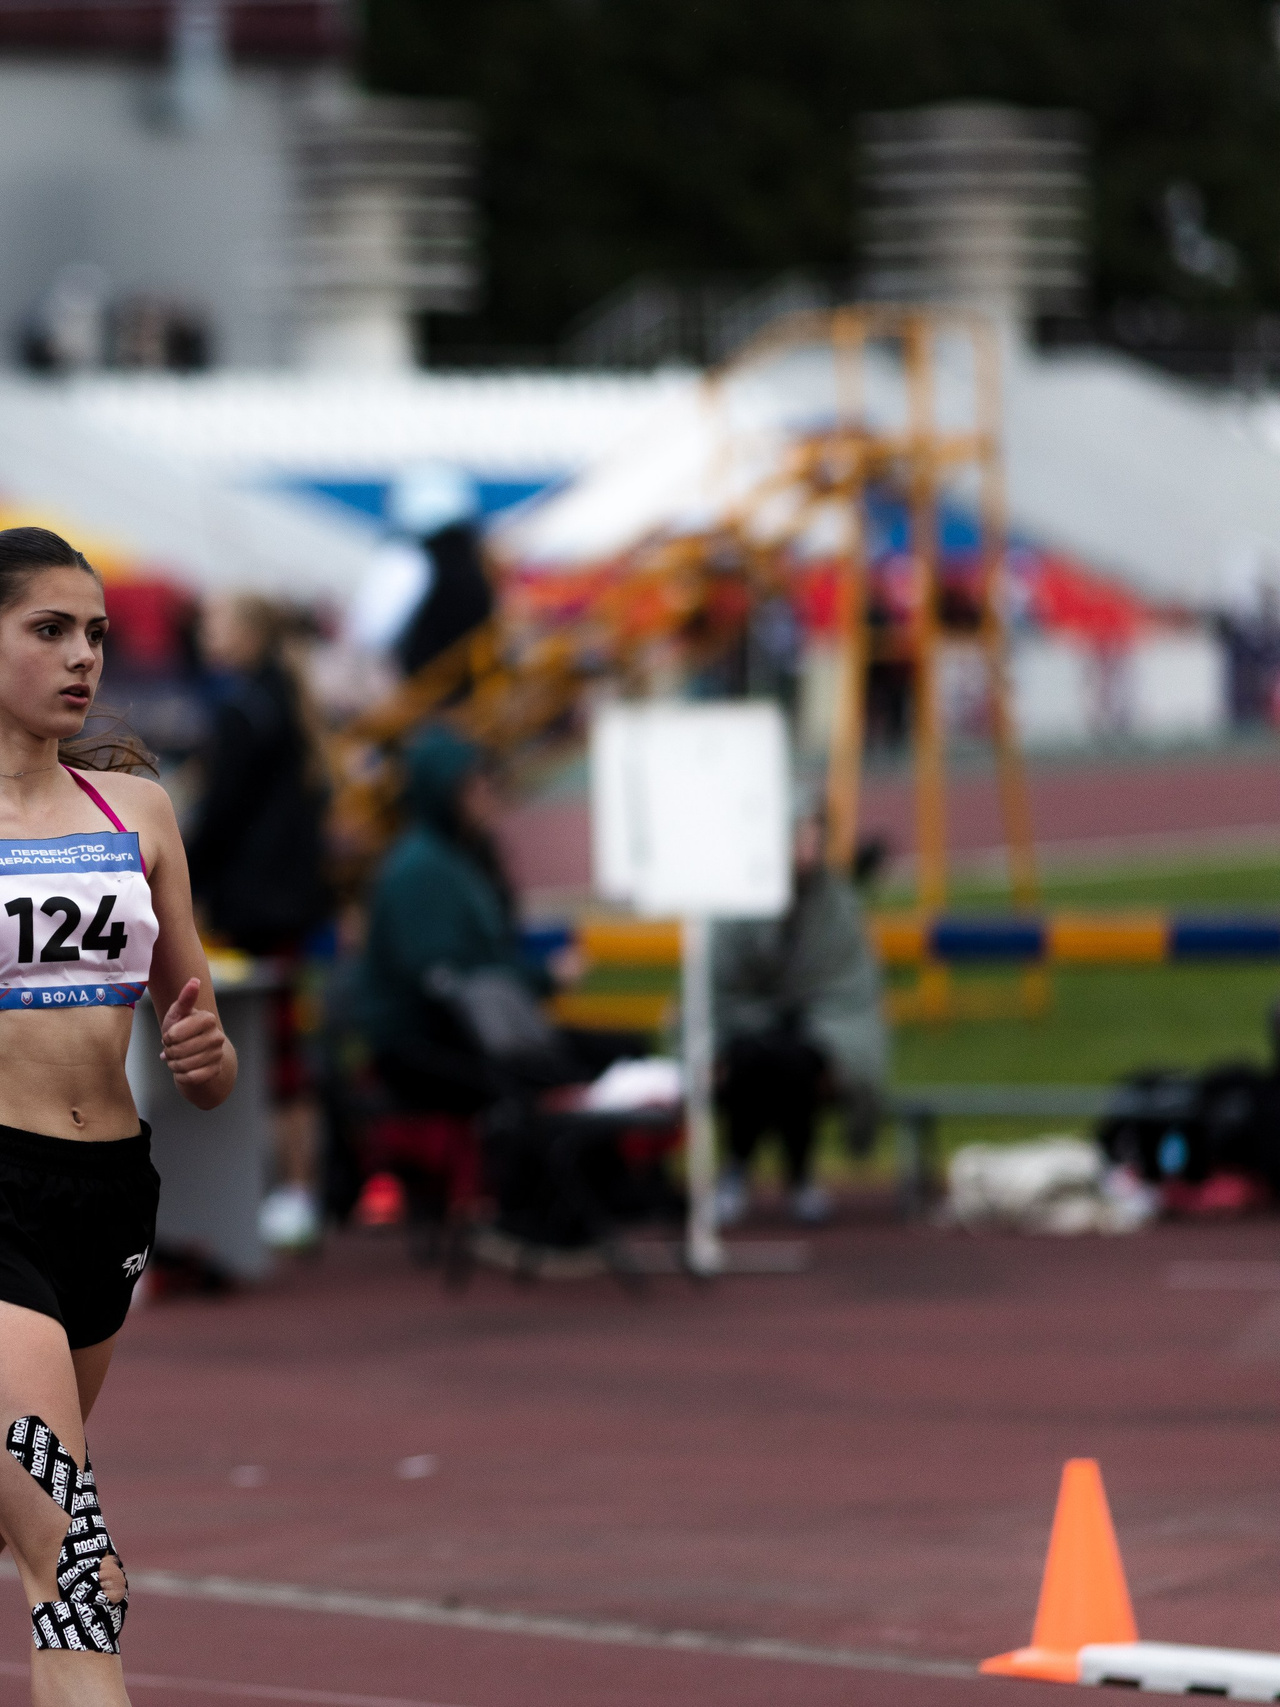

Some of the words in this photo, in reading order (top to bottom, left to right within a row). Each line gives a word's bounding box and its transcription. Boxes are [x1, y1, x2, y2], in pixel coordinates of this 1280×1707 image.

[10, 844, 106, 857] ПЕРВЕНСТВО
[4, 895, 128, 963] 124
[42, 991, 90, 1004] ВФЛА
[30, 1425, 49, 1478] ROCKTAPE
[52, 1460, 69, 1505] OCKTAPE
